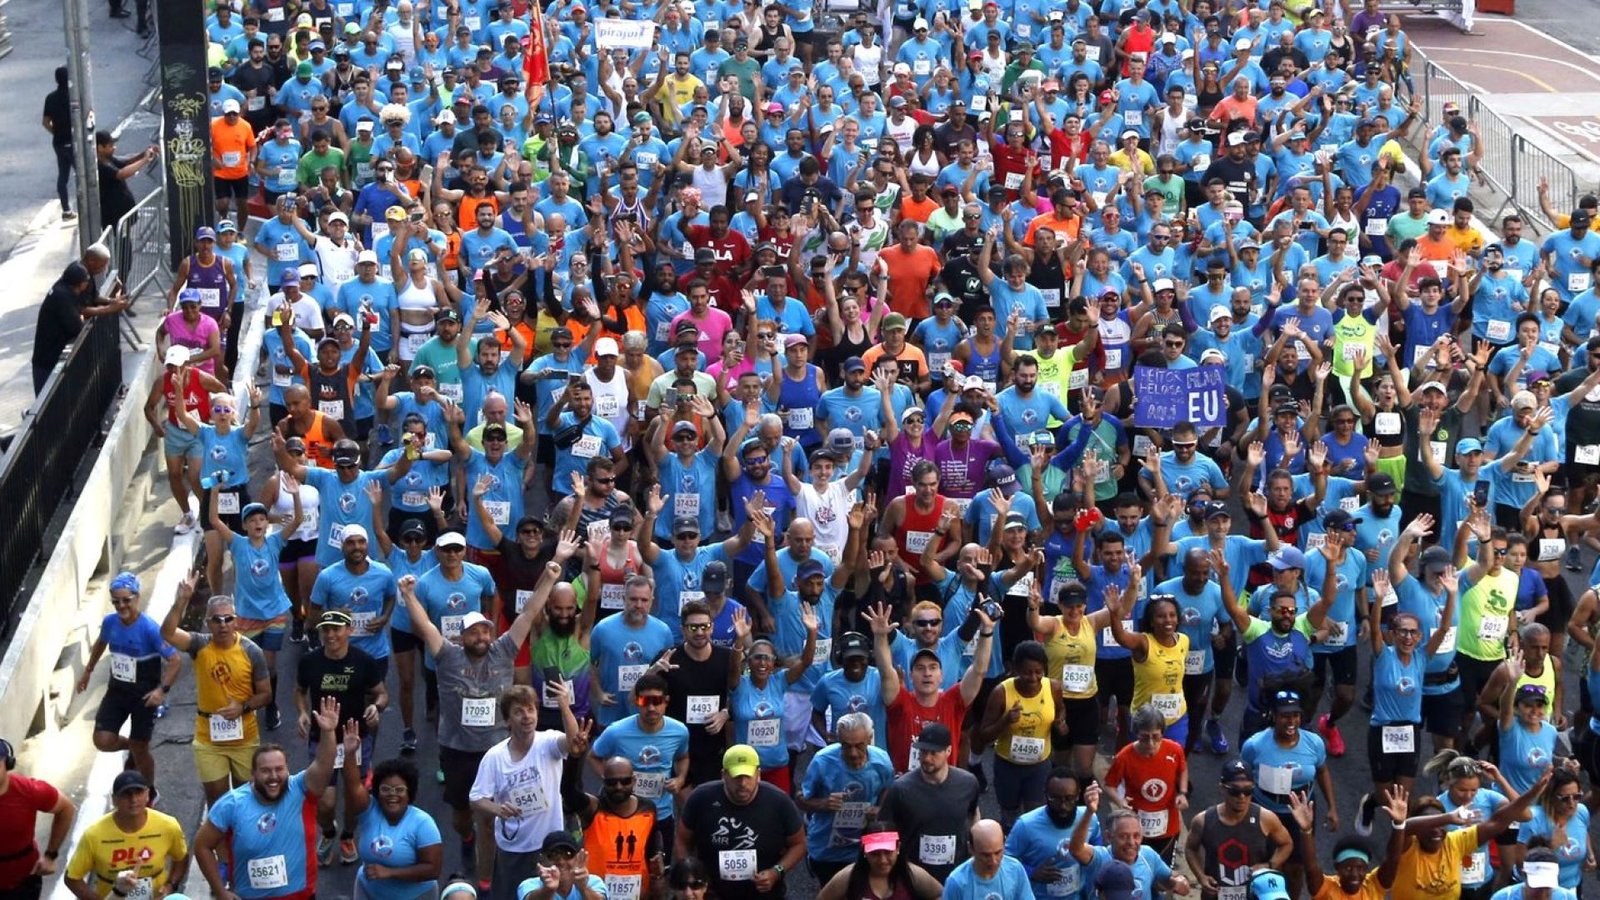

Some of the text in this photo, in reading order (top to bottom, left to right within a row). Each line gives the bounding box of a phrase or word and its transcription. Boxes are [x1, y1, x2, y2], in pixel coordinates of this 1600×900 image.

[1188, 389, 1219, 422] EU
[676, 499, 698, 508] 37432
[465, 705, 490, 716] 17093
[690, 702, 711, 713] 4493
[212, 720, 238, 731] 11089
[750, 727, 775, 737] 10920
[1012, 742, 1039, 754] 24496
[637, 777, 659, 788] 3861
[515, 793, 538, 806] 9541
[924, 842, 946, 853] 3398
[725, 858, 748, 869] 5058
[250, 864, 280, 879] 25621
[607, 881, 635, 894] 11857
